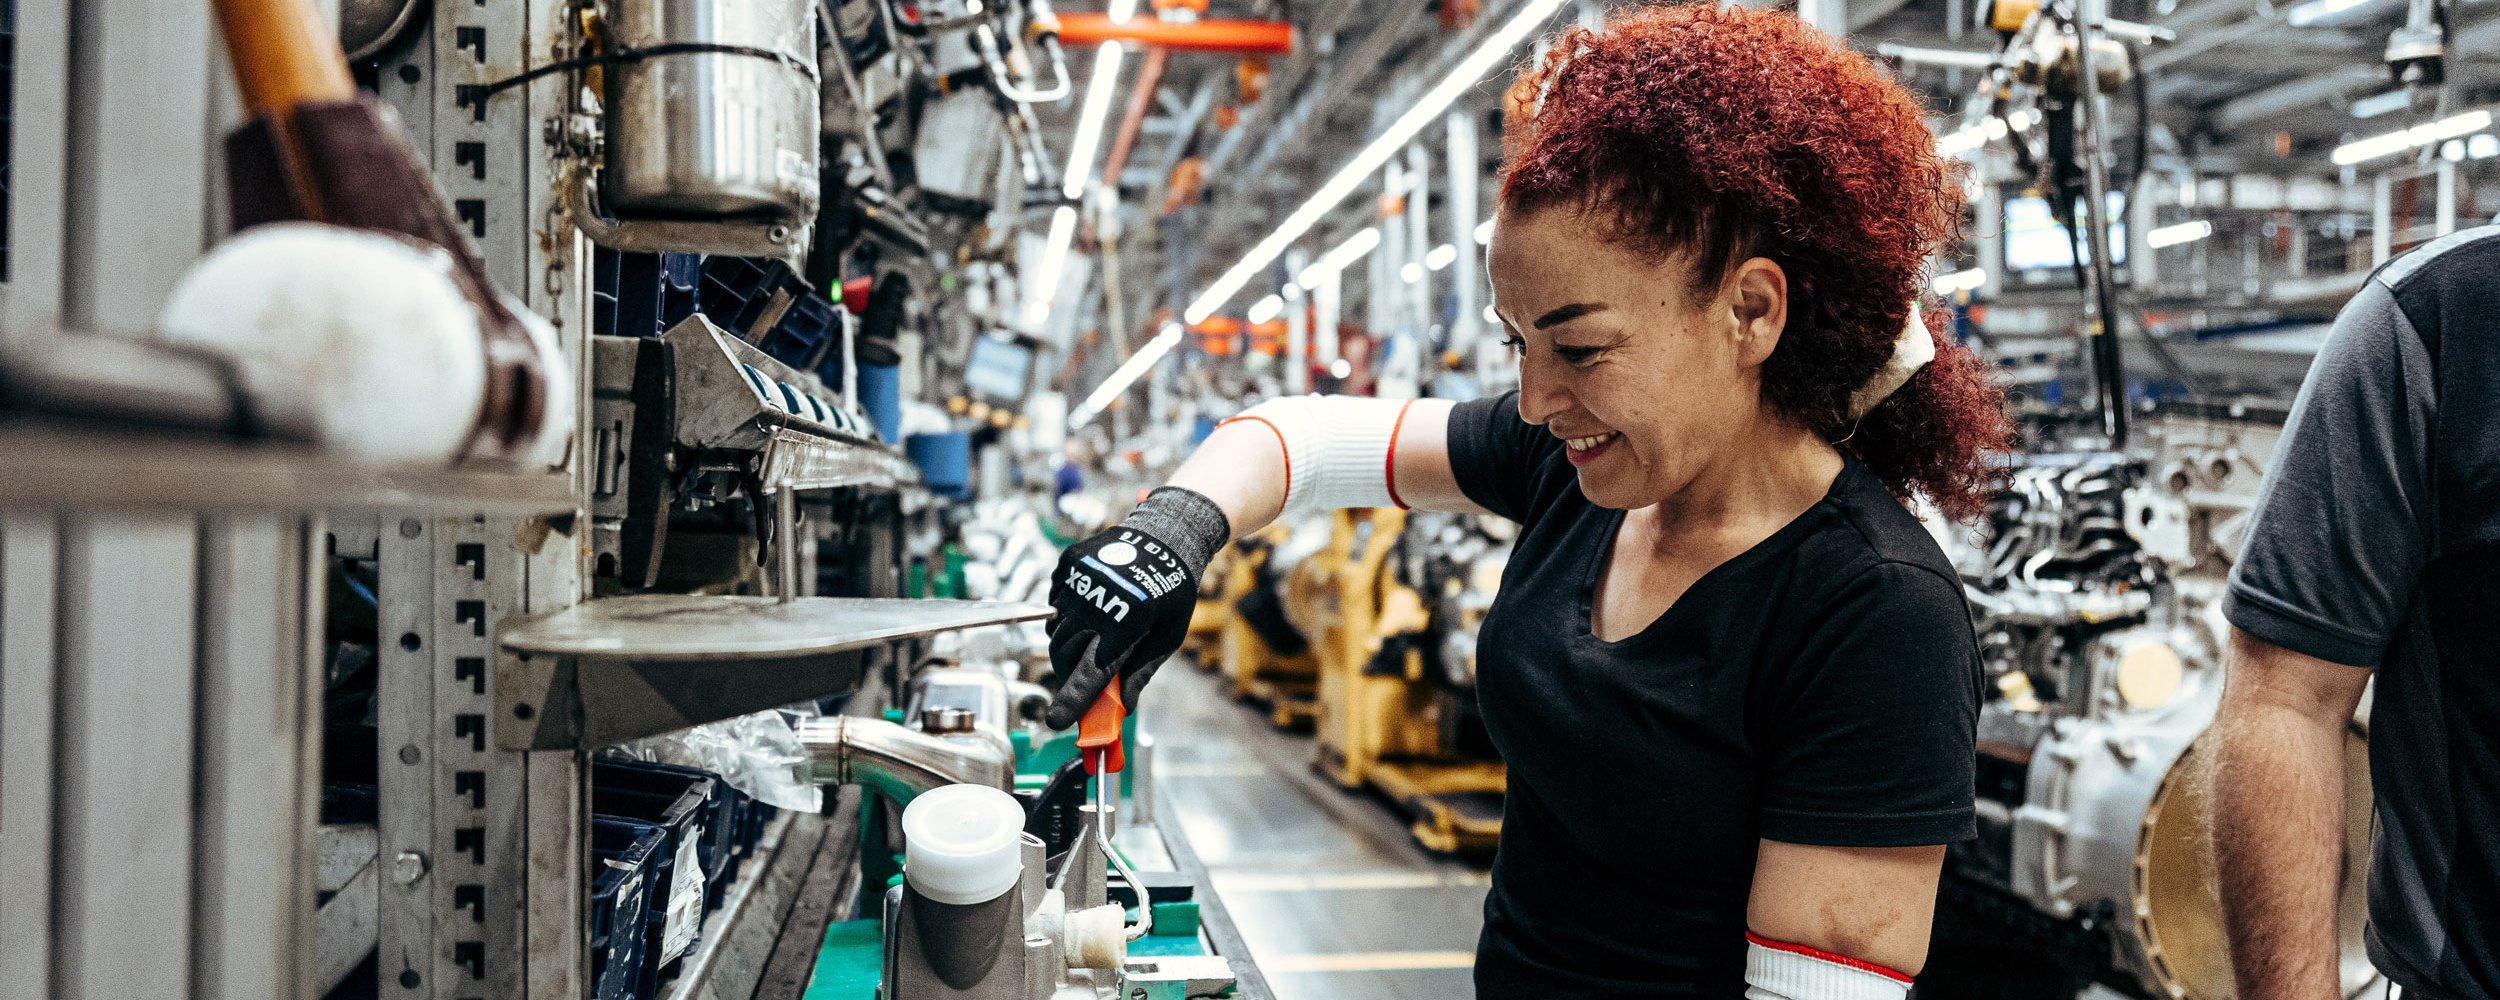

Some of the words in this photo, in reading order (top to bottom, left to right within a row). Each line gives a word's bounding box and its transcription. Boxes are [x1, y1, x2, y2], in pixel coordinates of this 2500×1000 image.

[1065, 566, 1130, 623] uvex
[1128, 565, 1164, 596] GERMANY
[1140, 580, 1159, 599] MADE
